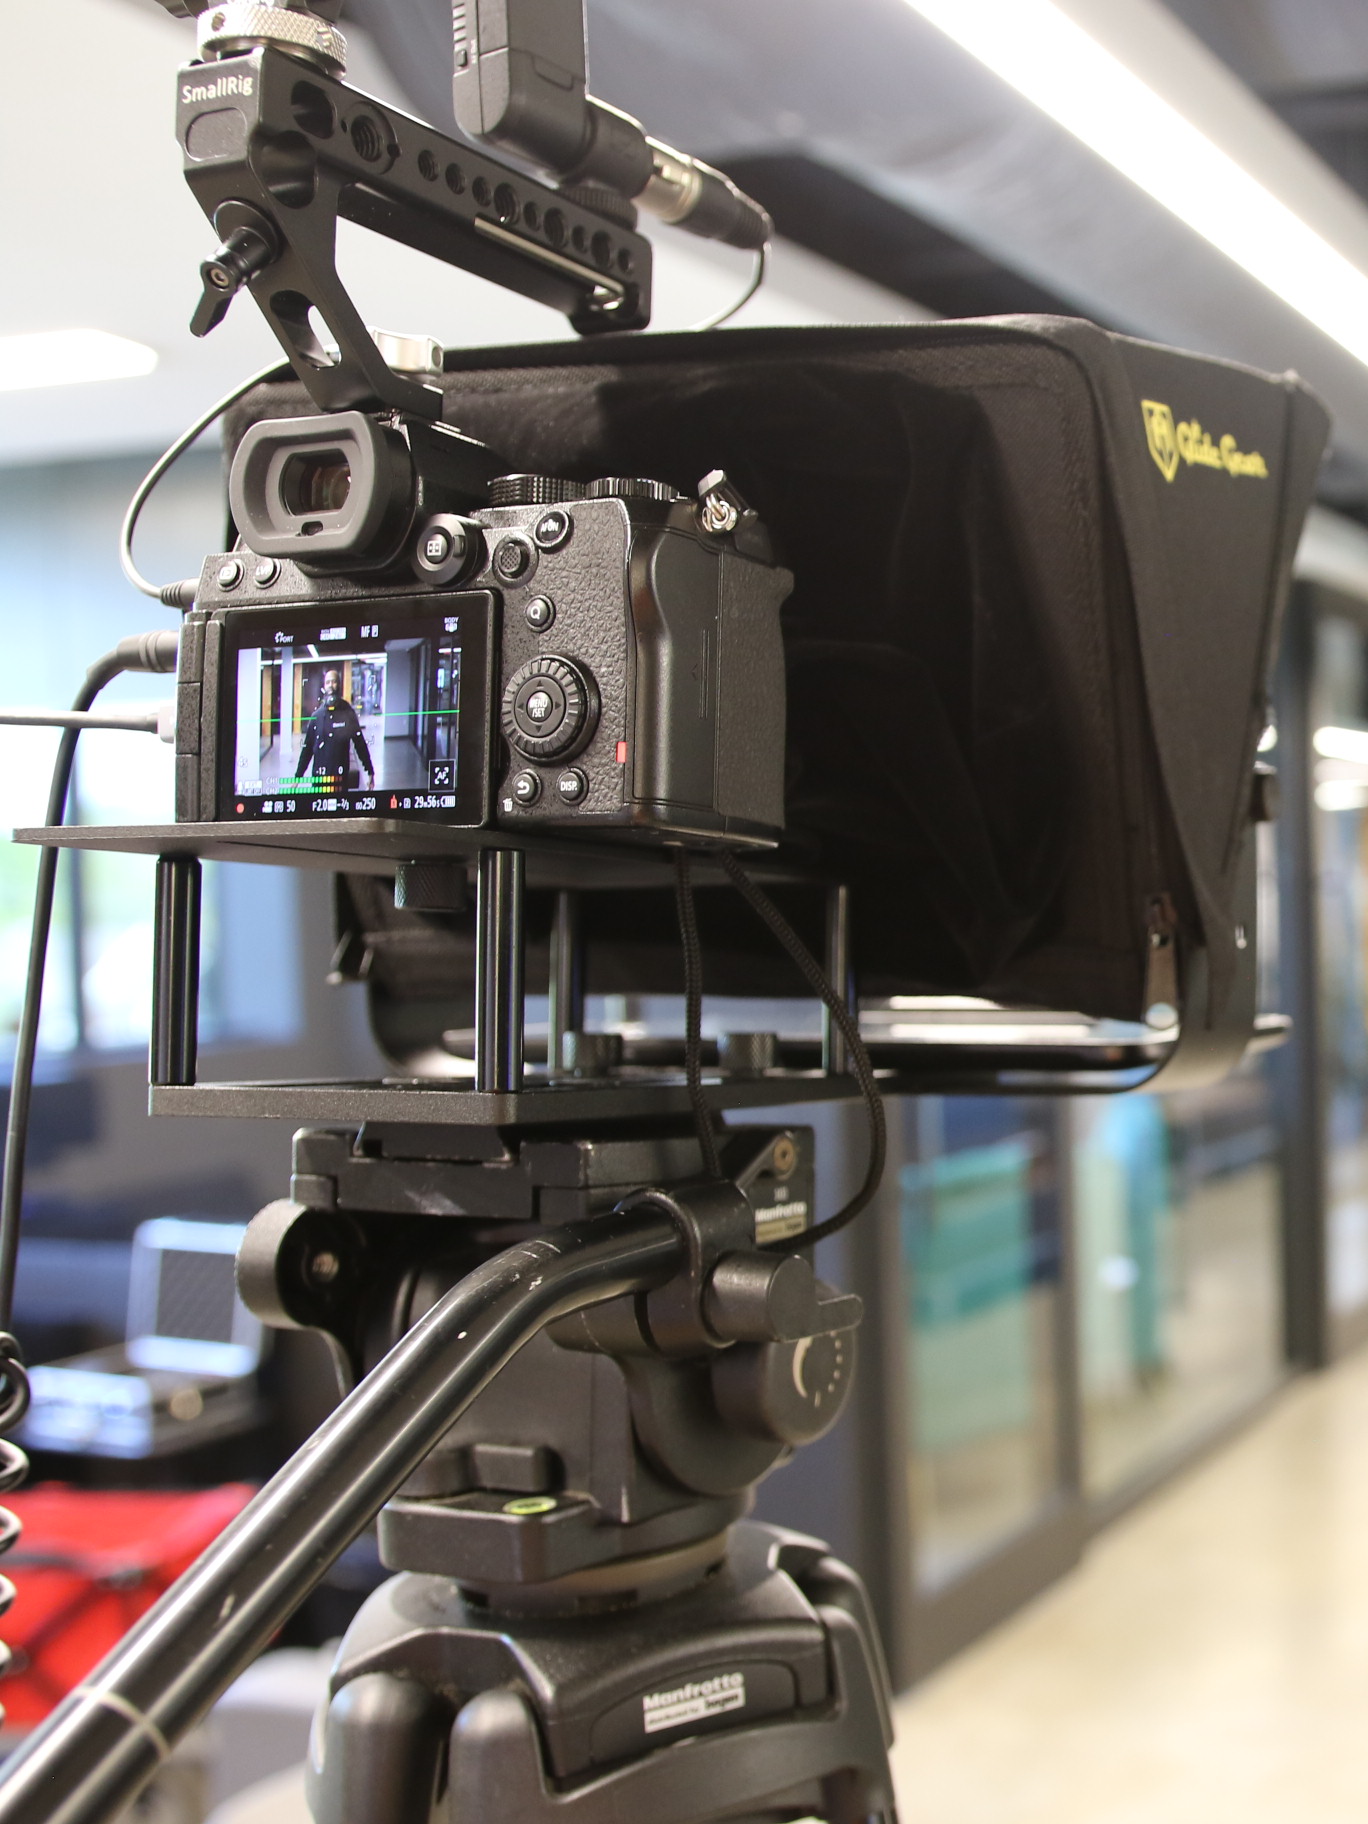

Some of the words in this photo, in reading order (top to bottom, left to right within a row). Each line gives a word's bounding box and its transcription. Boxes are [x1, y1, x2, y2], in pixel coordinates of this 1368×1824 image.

[181, 74, 254, 104] SmallRig
[530, 605, 540, 620] Q
[360, 625, 371, 638] MF
[529, 698, 548, 709] MENU
[338, 765, 344, 775] 0
[436, 771, 447, 780] AF
[286, 800, 296, 812] 50
[755, 1201, 807, 1223] Manfrotto
[643, 1672, 744, 1711] Manfrotto
